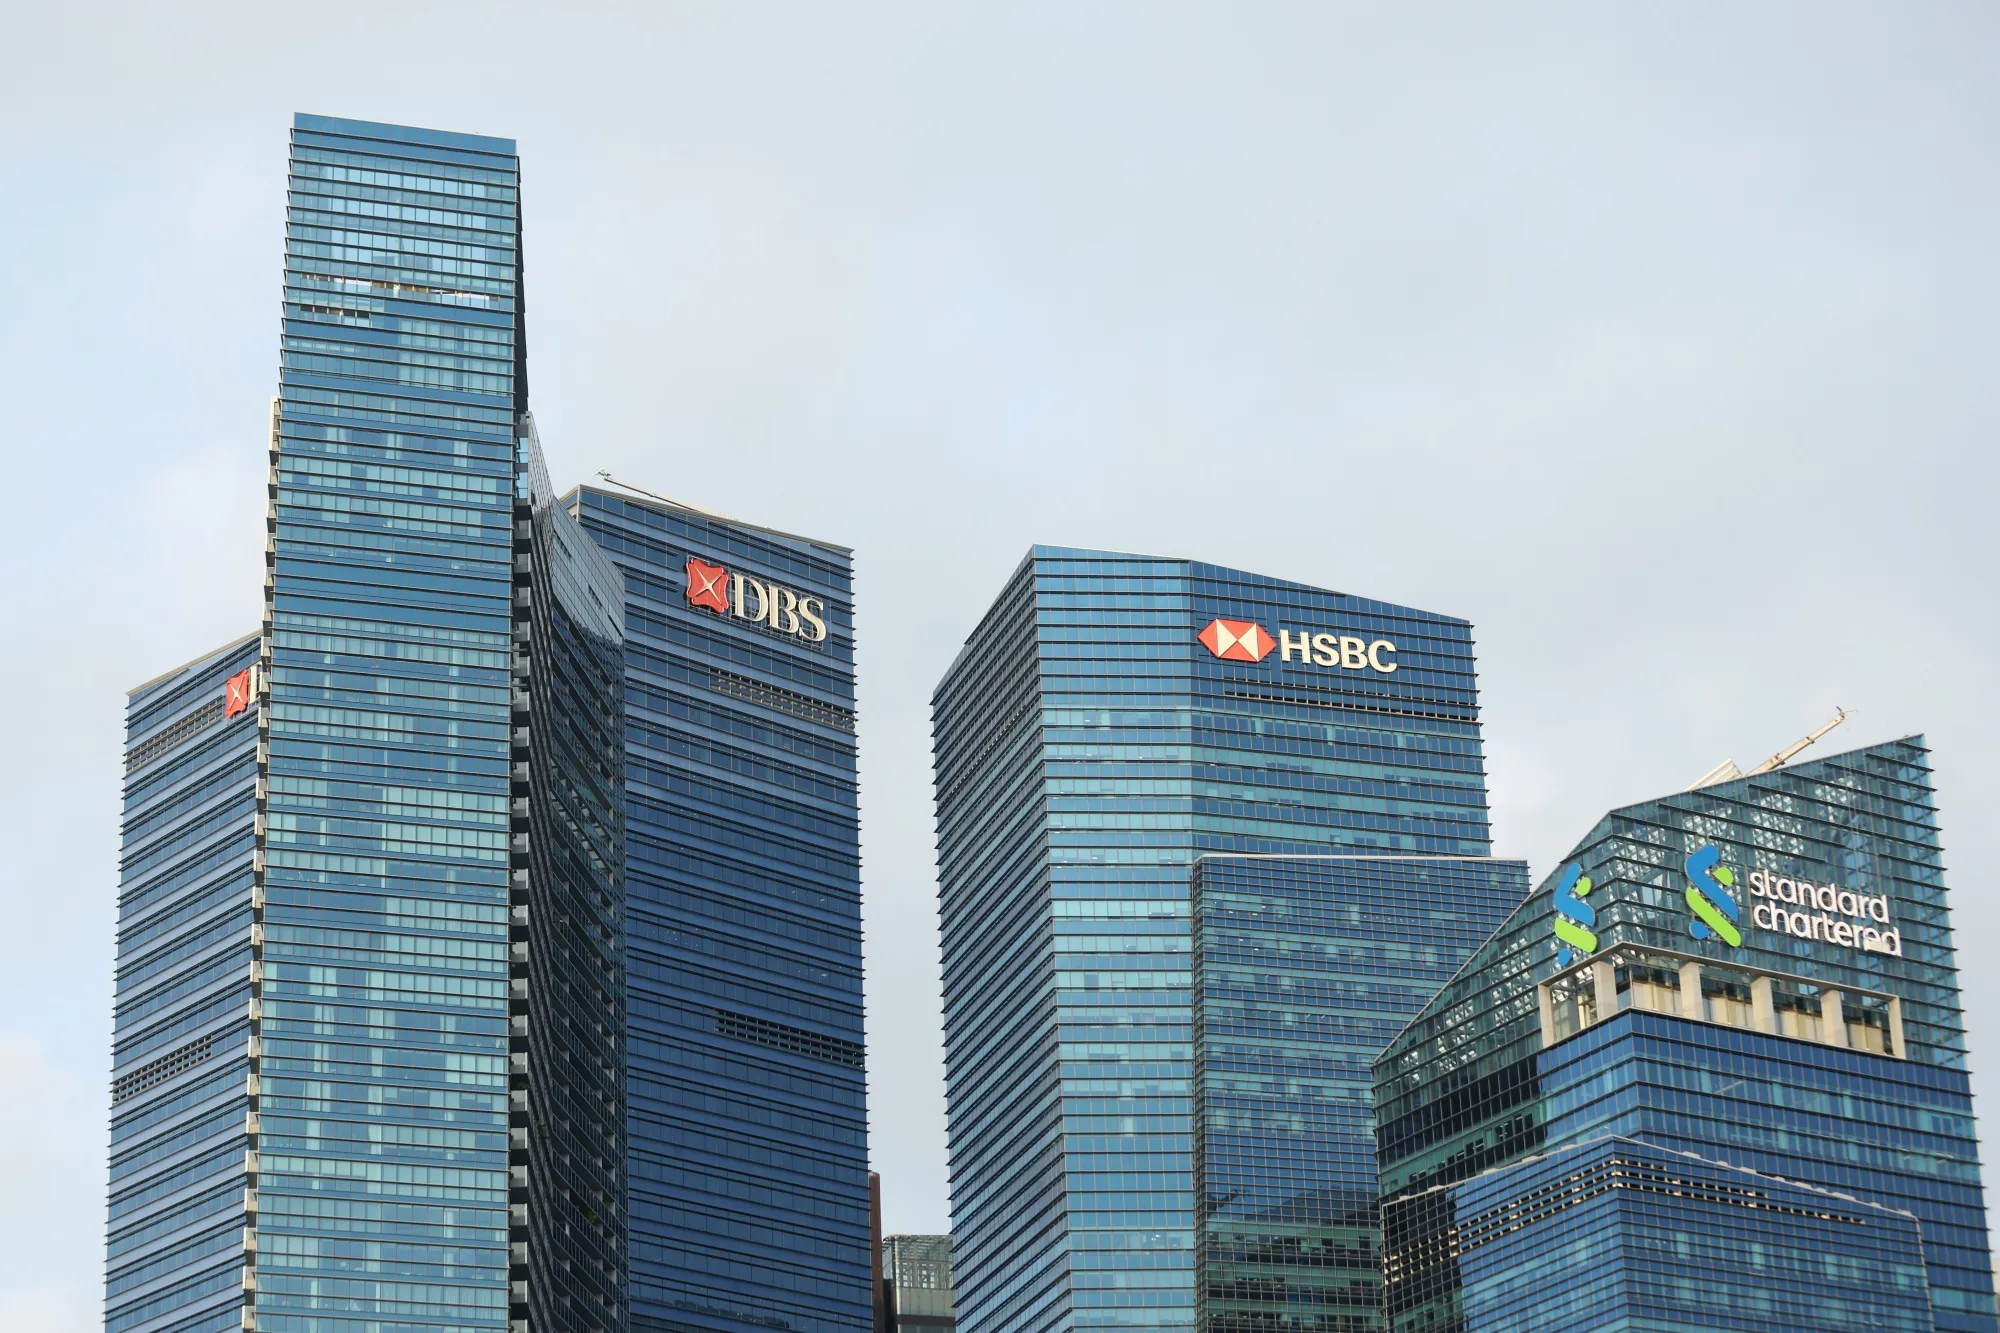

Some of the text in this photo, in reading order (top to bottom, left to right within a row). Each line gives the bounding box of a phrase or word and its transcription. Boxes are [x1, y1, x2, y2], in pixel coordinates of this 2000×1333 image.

[732, 573, 827, 642] DBS
[1280, 629, 1398, 673] HSBC
[1749, 869, 1889, 924] standard
[1753, 900, 1902, 957] chartered
